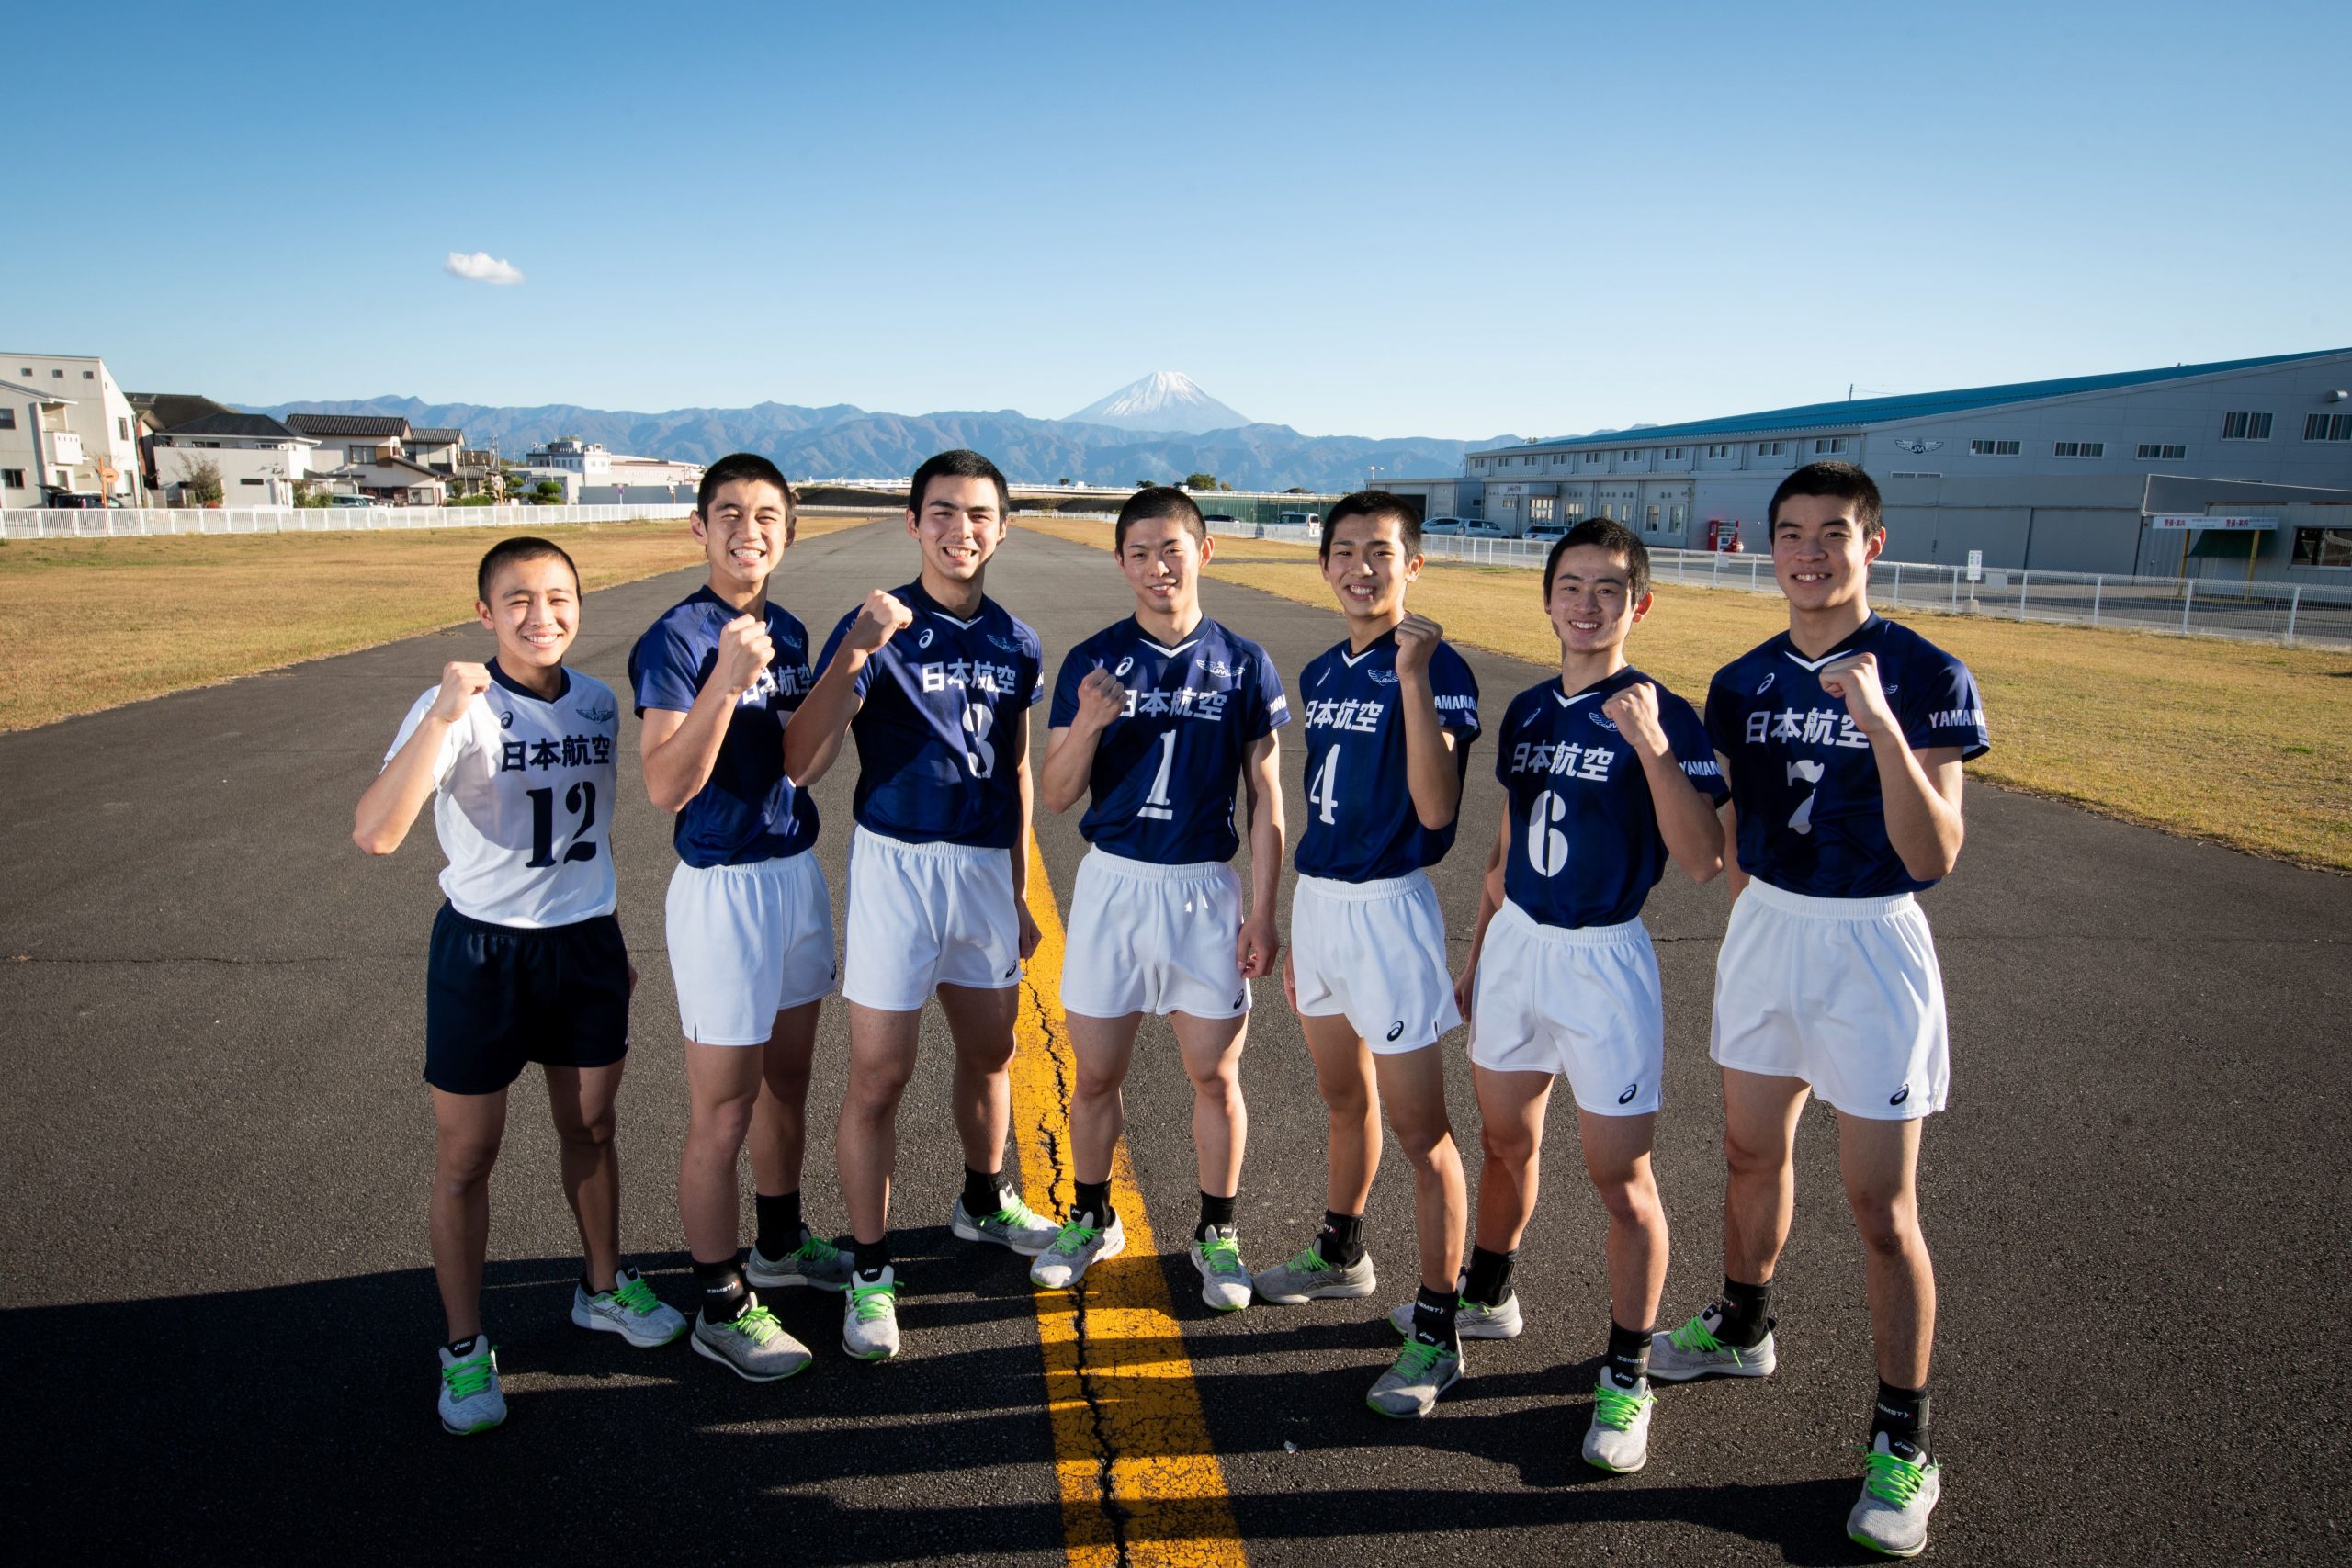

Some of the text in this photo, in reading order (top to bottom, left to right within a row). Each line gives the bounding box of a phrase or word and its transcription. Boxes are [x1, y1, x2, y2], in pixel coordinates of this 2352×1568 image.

[922, 658, 1016, 695] 日本航空
[1119, 687, 1228, 722] 日本航空
[962, 703, 995, 779] 3
[1305, 698, 1385, 733] 日本航空
[1746, 707, 1870, 749] 日本航空
[501, 734, 610, 772] 日本航空
[1145, 729, 1177, 806] 1
[1511, 740, 1614, 782] 日本航空
[1309, 744, 1340, 825] 4
[1787, 760, 1825, 835] 7
[526, 781, 597, 868] 12
[1528, 790, 1568, 878] 6
